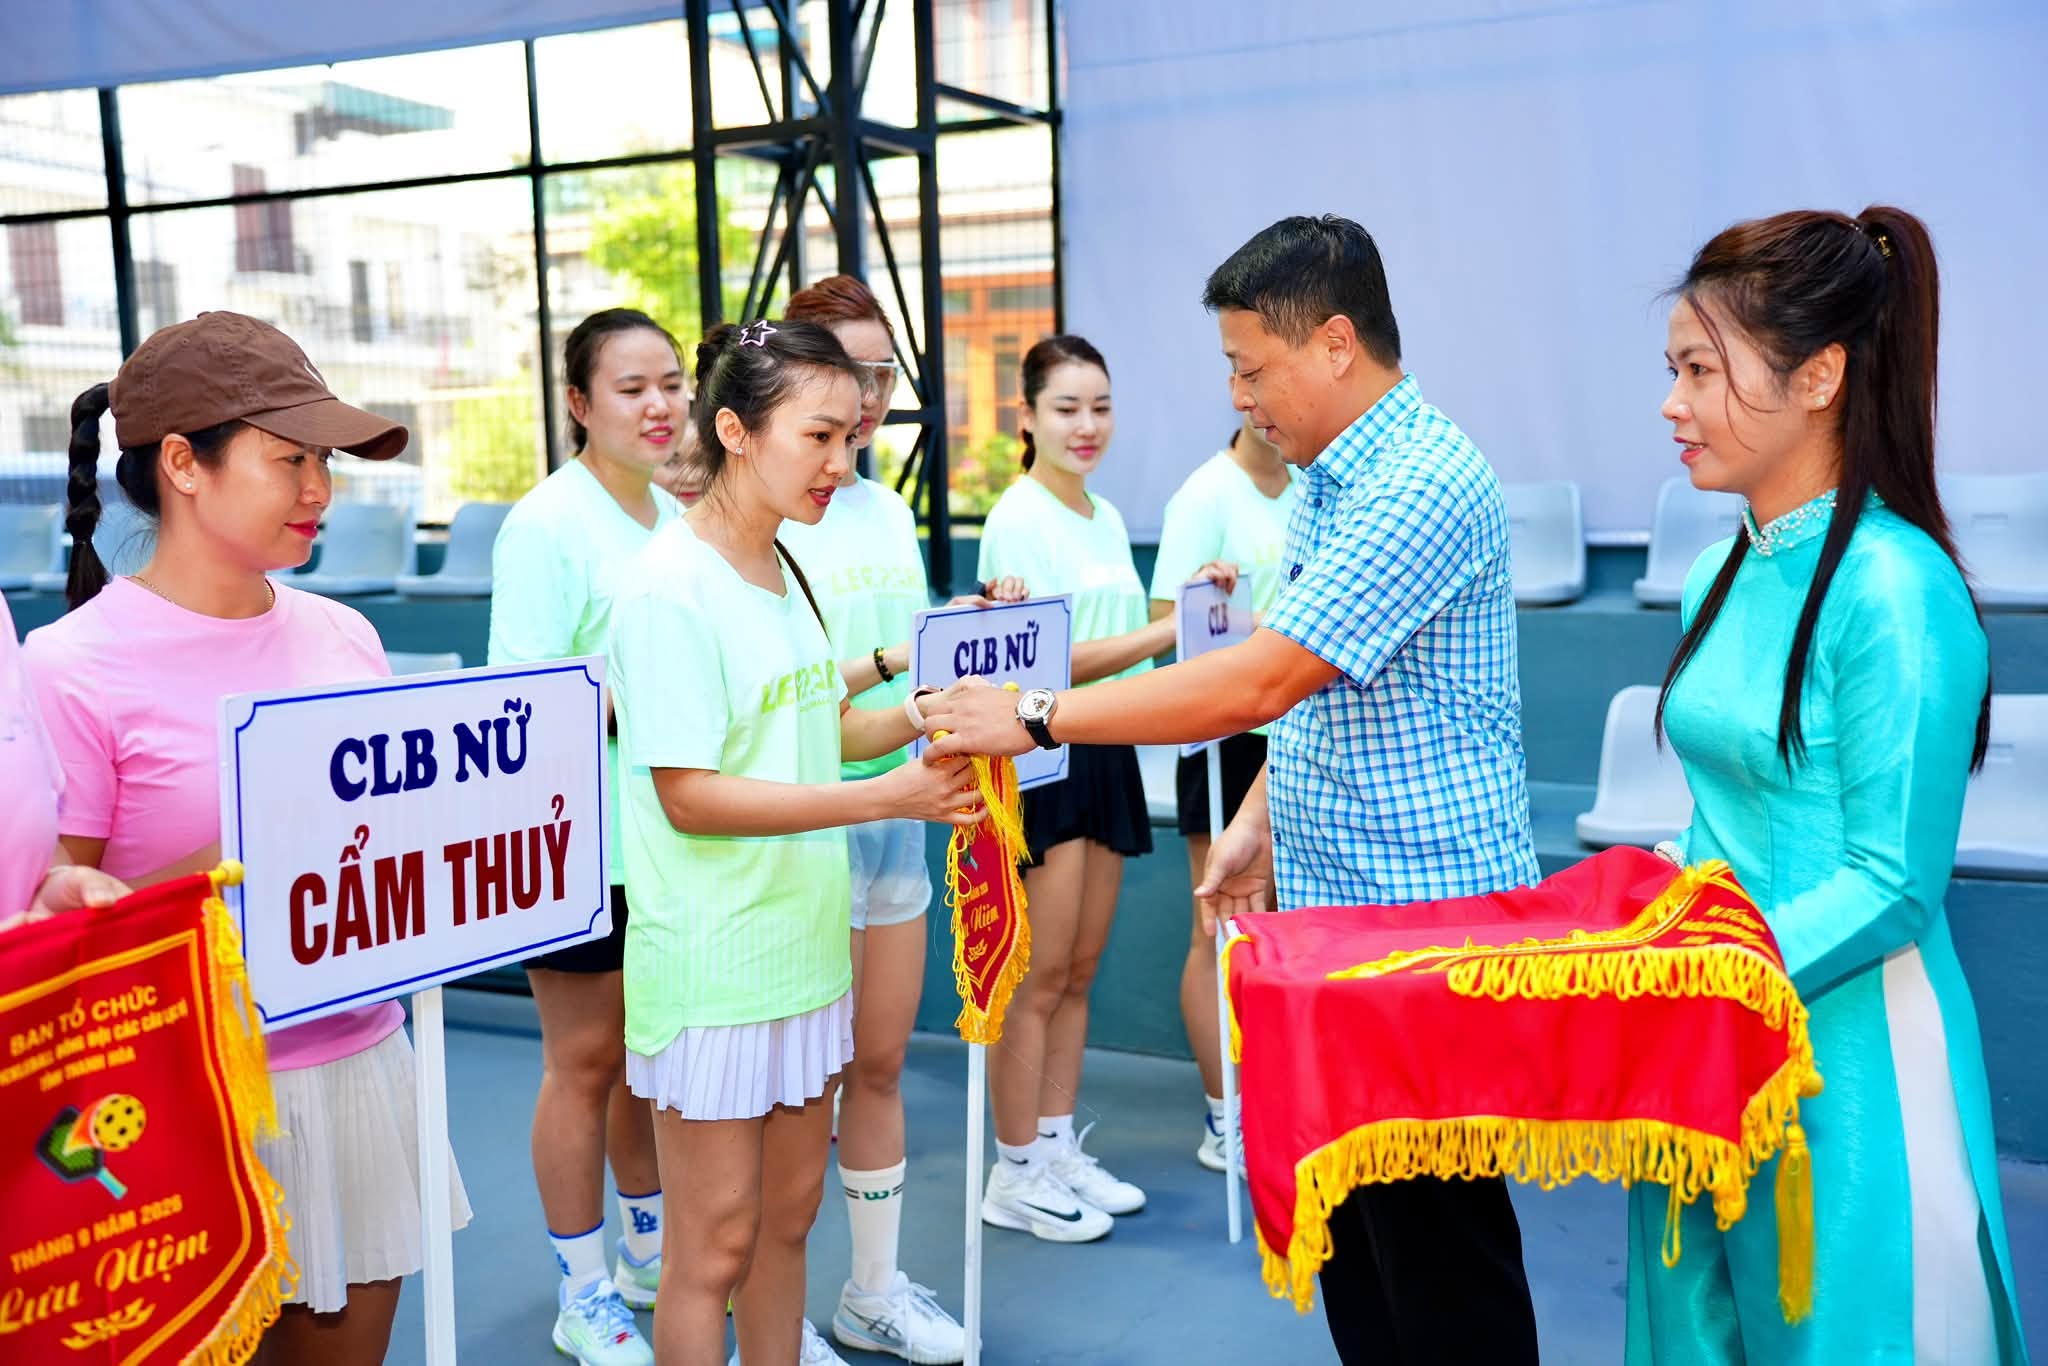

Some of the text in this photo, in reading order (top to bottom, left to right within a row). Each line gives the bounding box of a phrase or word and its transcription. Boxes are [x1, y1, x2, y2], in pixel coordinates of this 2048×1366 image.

[953, 620, 1039, 679] CLB NỮ
[1208, 603, 1229, 637] CLB
[329, 697, 532, 802] CLB NỮ
[289, 793, 572, 965] CẨM THUỶ
[10, 1021, 54, 1057] BAN
[91, 985, 158, 1022] CHỨC
[629, 1206, 658, 1234] LA
[95, 1230, 210, 1292] Niệm
